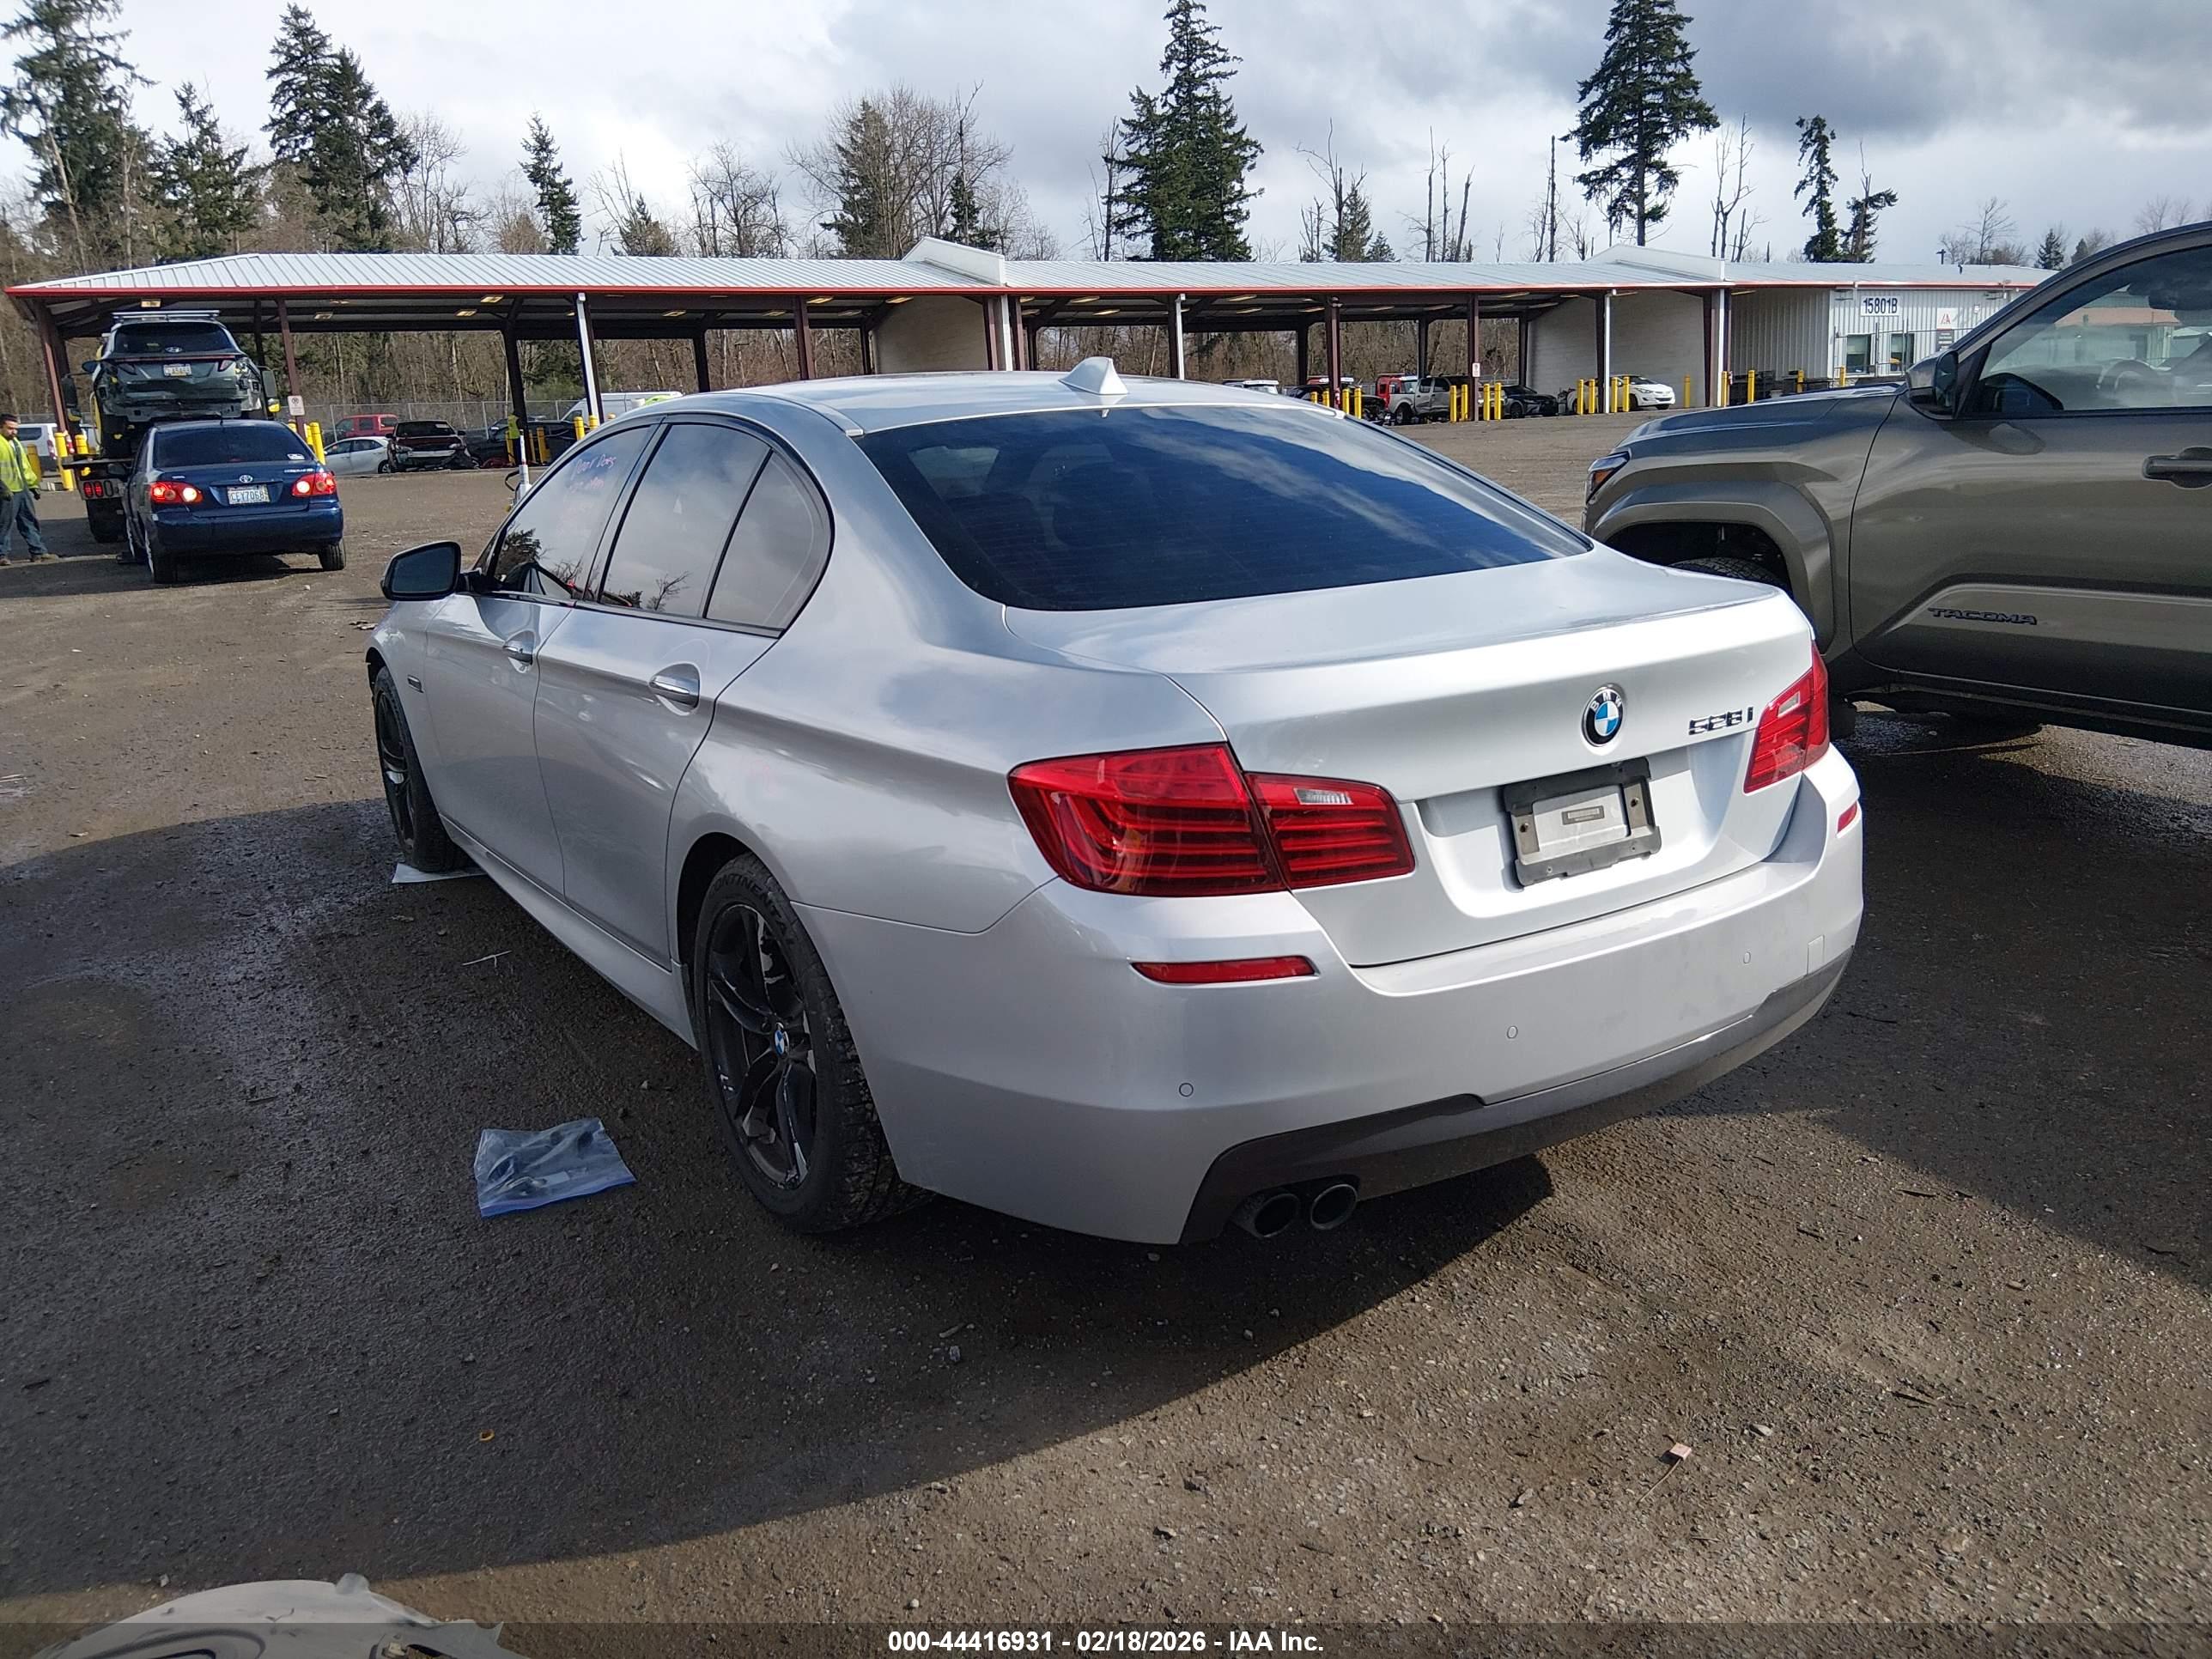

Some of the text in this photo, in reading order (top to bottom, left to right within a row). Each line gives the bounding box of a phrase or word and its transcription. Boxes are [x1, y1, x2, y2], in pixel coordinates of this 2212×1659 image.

[1863, 298, 1898, 313] 15801B
[1928, 608, 2038, 625] TACOMA
[1589, 691, 1622, 712] BMW
